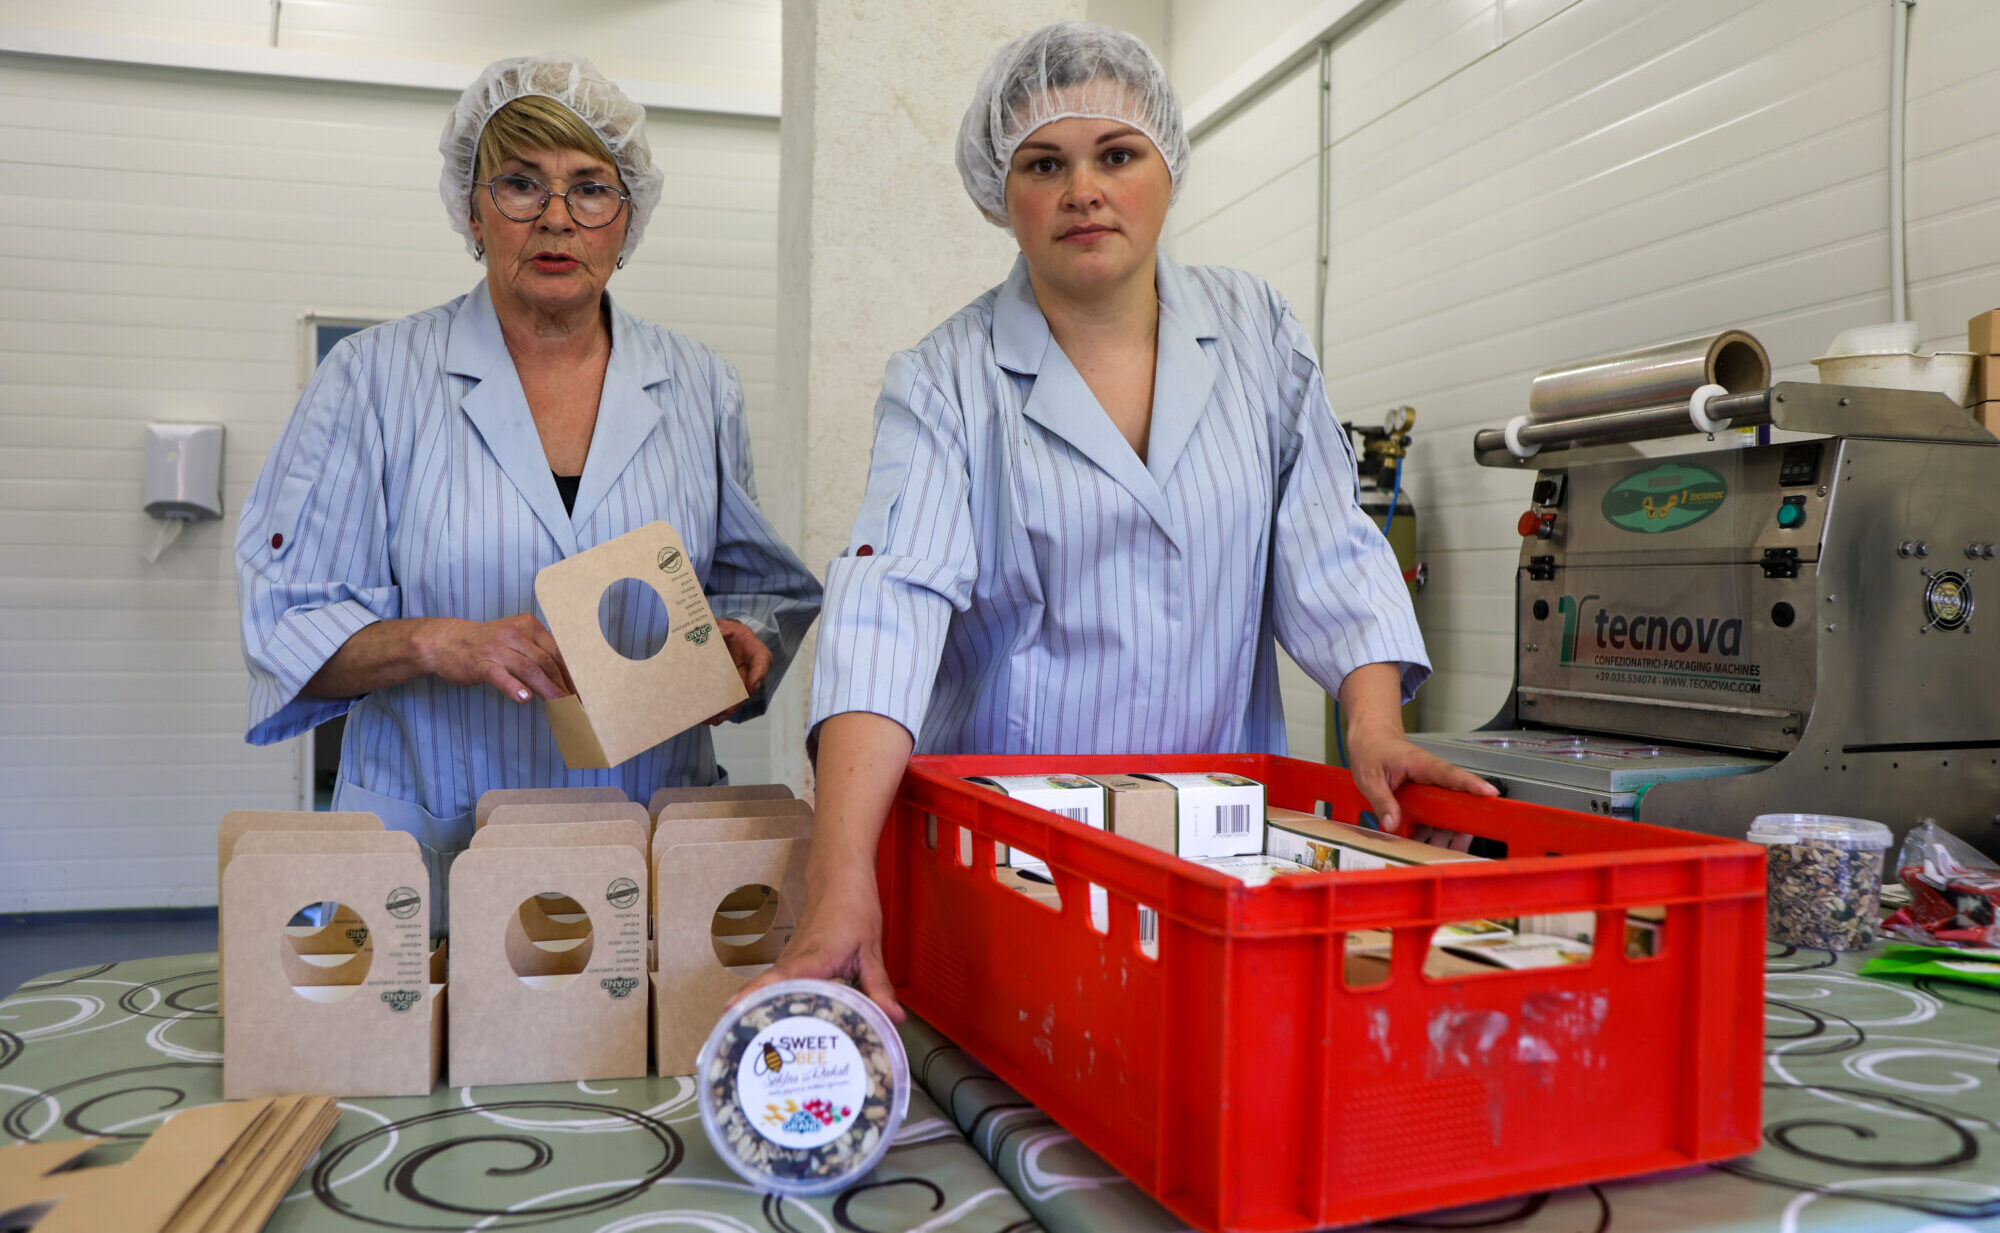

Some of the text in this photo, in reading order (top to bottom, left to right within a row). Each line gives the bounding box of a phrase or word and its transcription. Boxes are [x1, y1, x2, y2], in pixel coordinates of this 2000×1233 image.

[1714, 663, 1761, 676] MACHINES
[1662, 678, 1761, 694] WWW.TECNOVAC.COM
[601, 978, 638, 989] GRAND
[779, 1036, 839, 1050] SWEET
[796, 1050, 828, 1065] BEE
